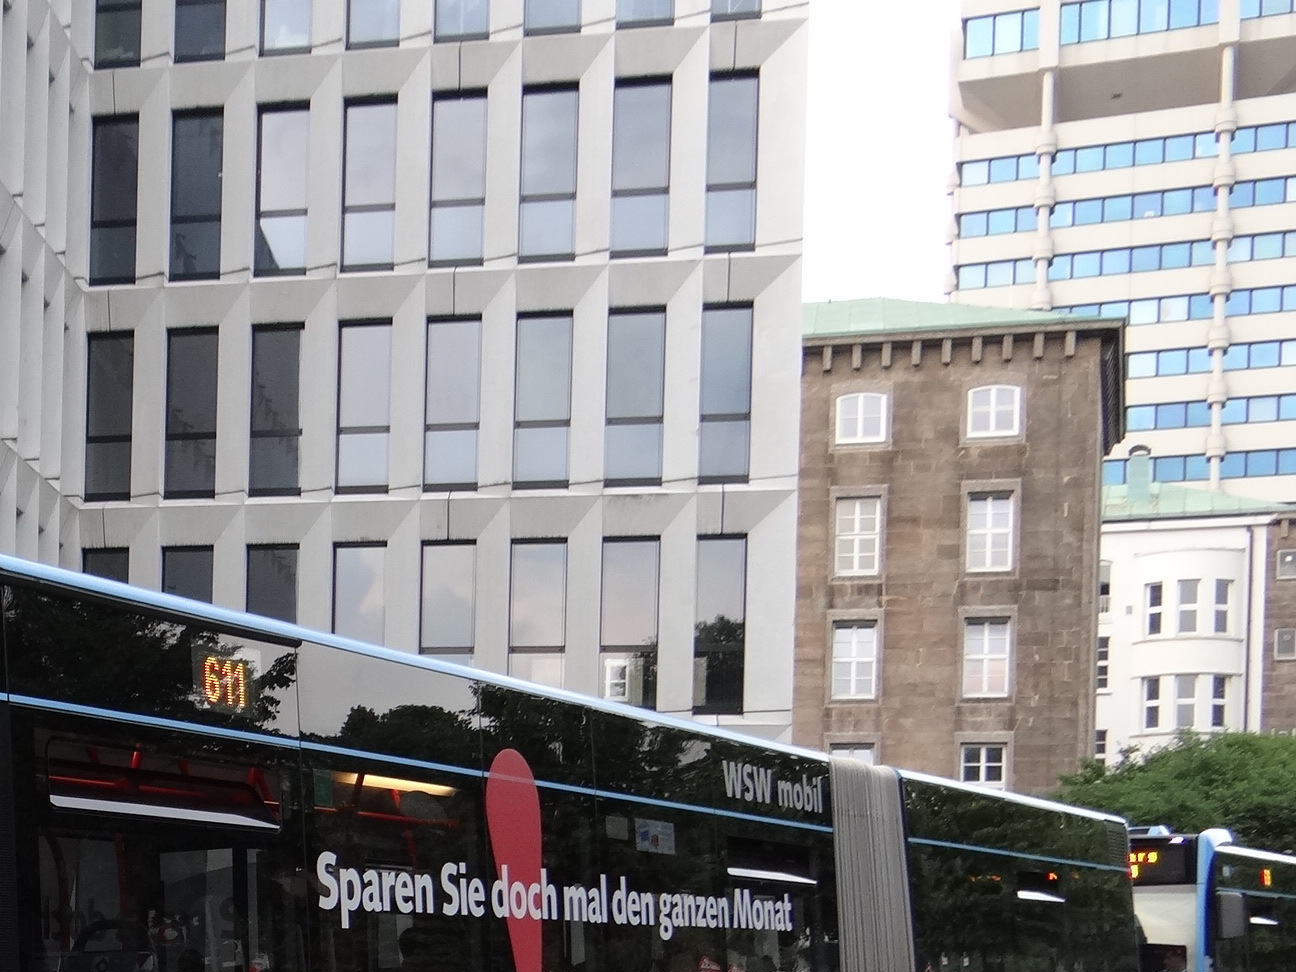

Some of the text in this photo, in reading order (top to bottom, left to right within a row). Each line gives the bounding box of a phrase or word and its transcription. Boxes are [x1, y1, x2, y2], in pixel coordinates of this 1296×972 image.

[205, 656, 245, 707] 611
[722, 760, 823, 814] WSW mobil
[317, 851, 793, 941] Sparen Sie doch mal den ganzen Monat
